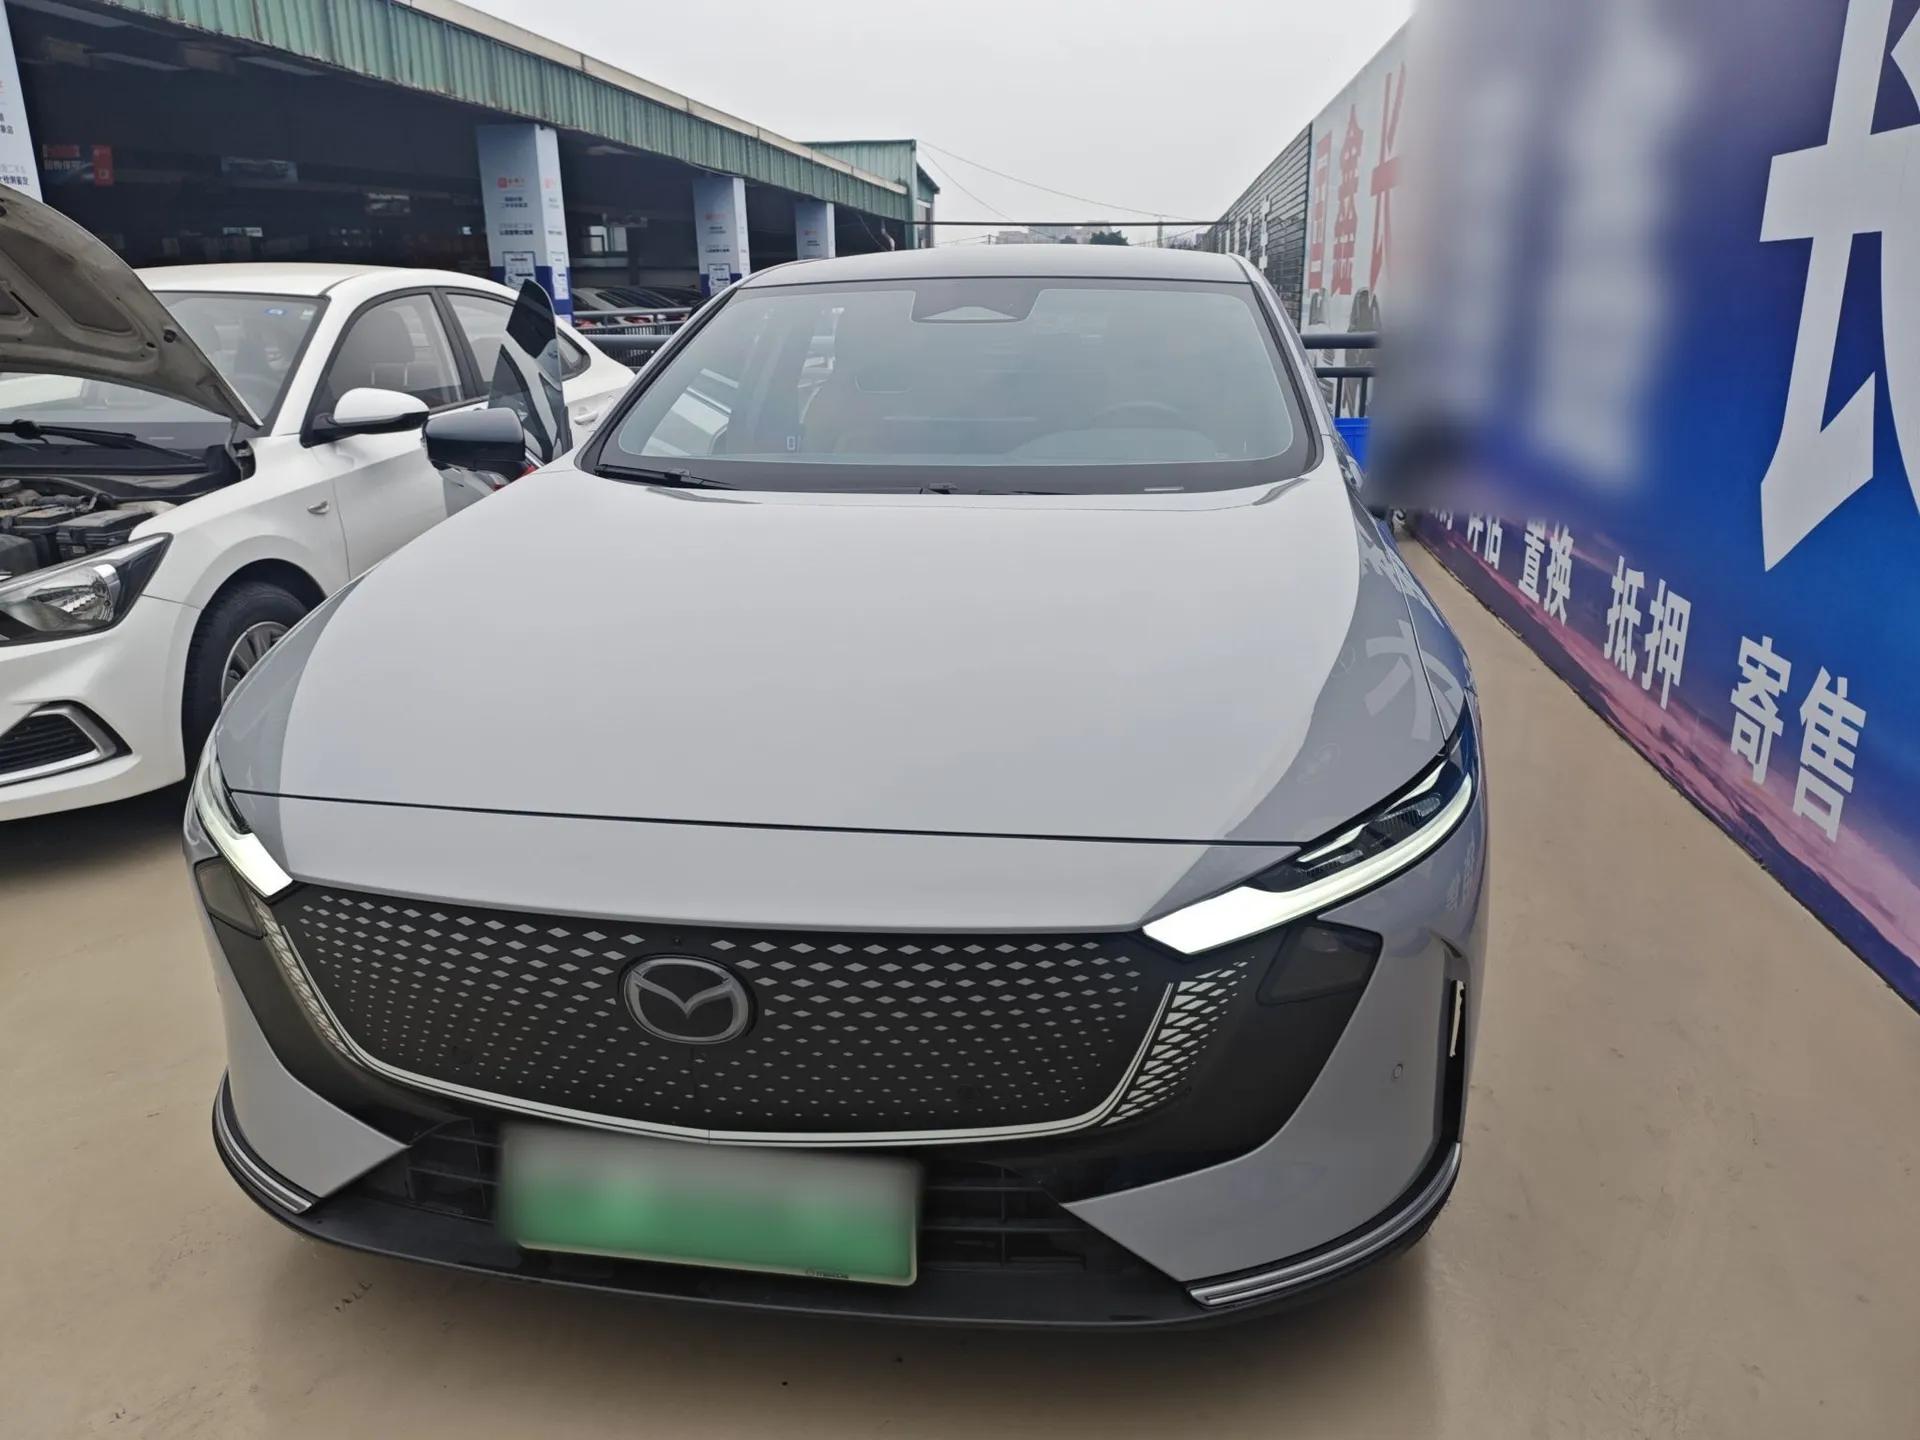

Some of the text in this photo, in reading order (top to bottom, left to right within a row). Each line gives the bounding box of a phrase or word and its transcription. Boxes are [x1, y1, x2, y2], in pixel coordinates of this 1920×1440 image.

[1518, 517, 1575, 627] 置换
[1604, 556, 1692, 711] 抵押
[1730, 636, 1867, 843] 寄售
